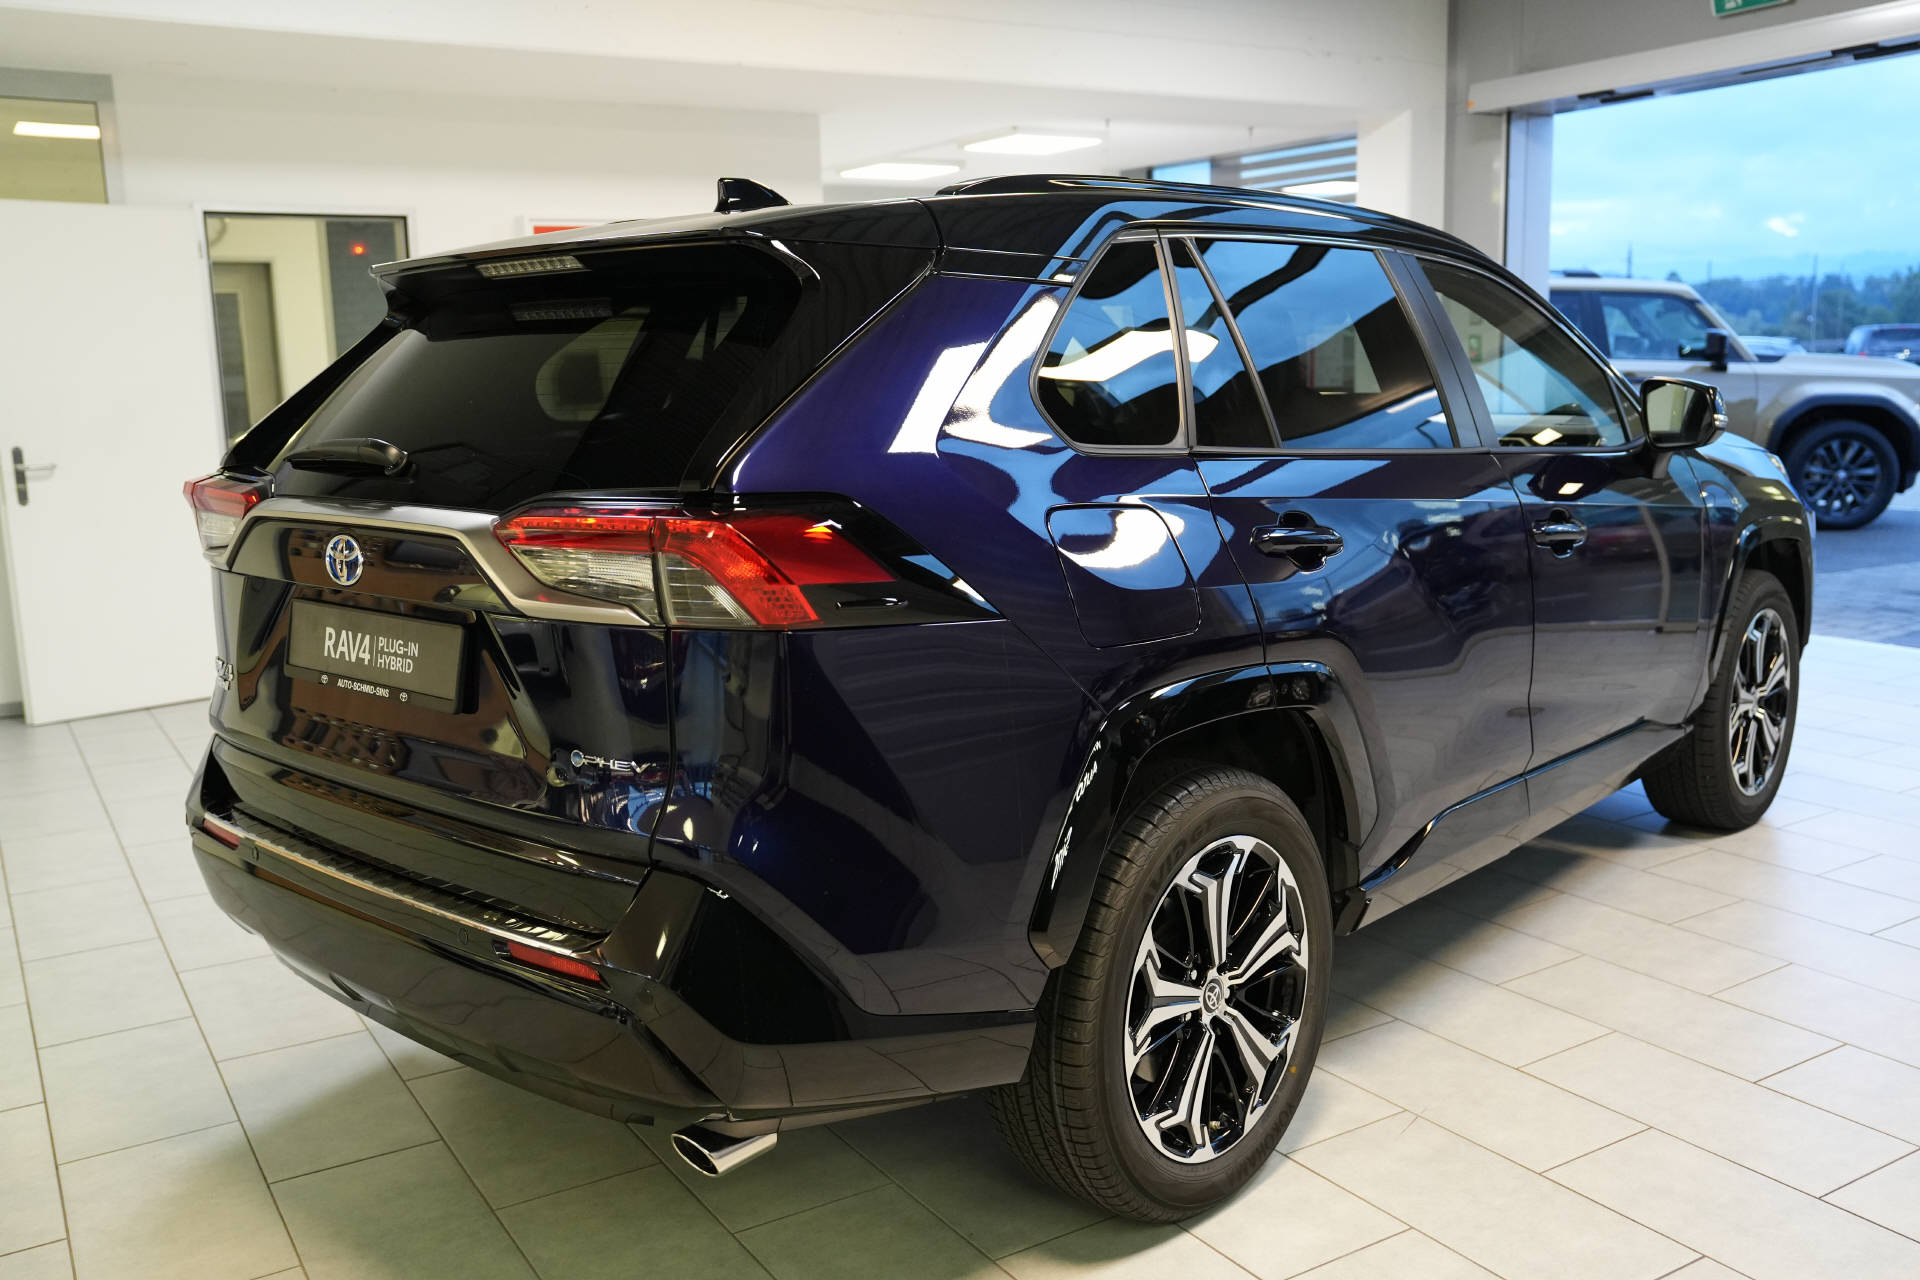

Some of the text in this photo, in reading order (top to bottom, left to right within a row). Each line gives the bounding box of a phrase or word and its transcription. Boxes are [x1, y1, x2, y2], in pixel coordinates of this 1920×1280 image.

[324, 626, 371, 666] RAV4
[378, 636, 419, 657] PLUG-IN
[377, 653, 414, 674] HYBRID
[337, 678, 390, 698] AUTO-SCHMID-SINS
